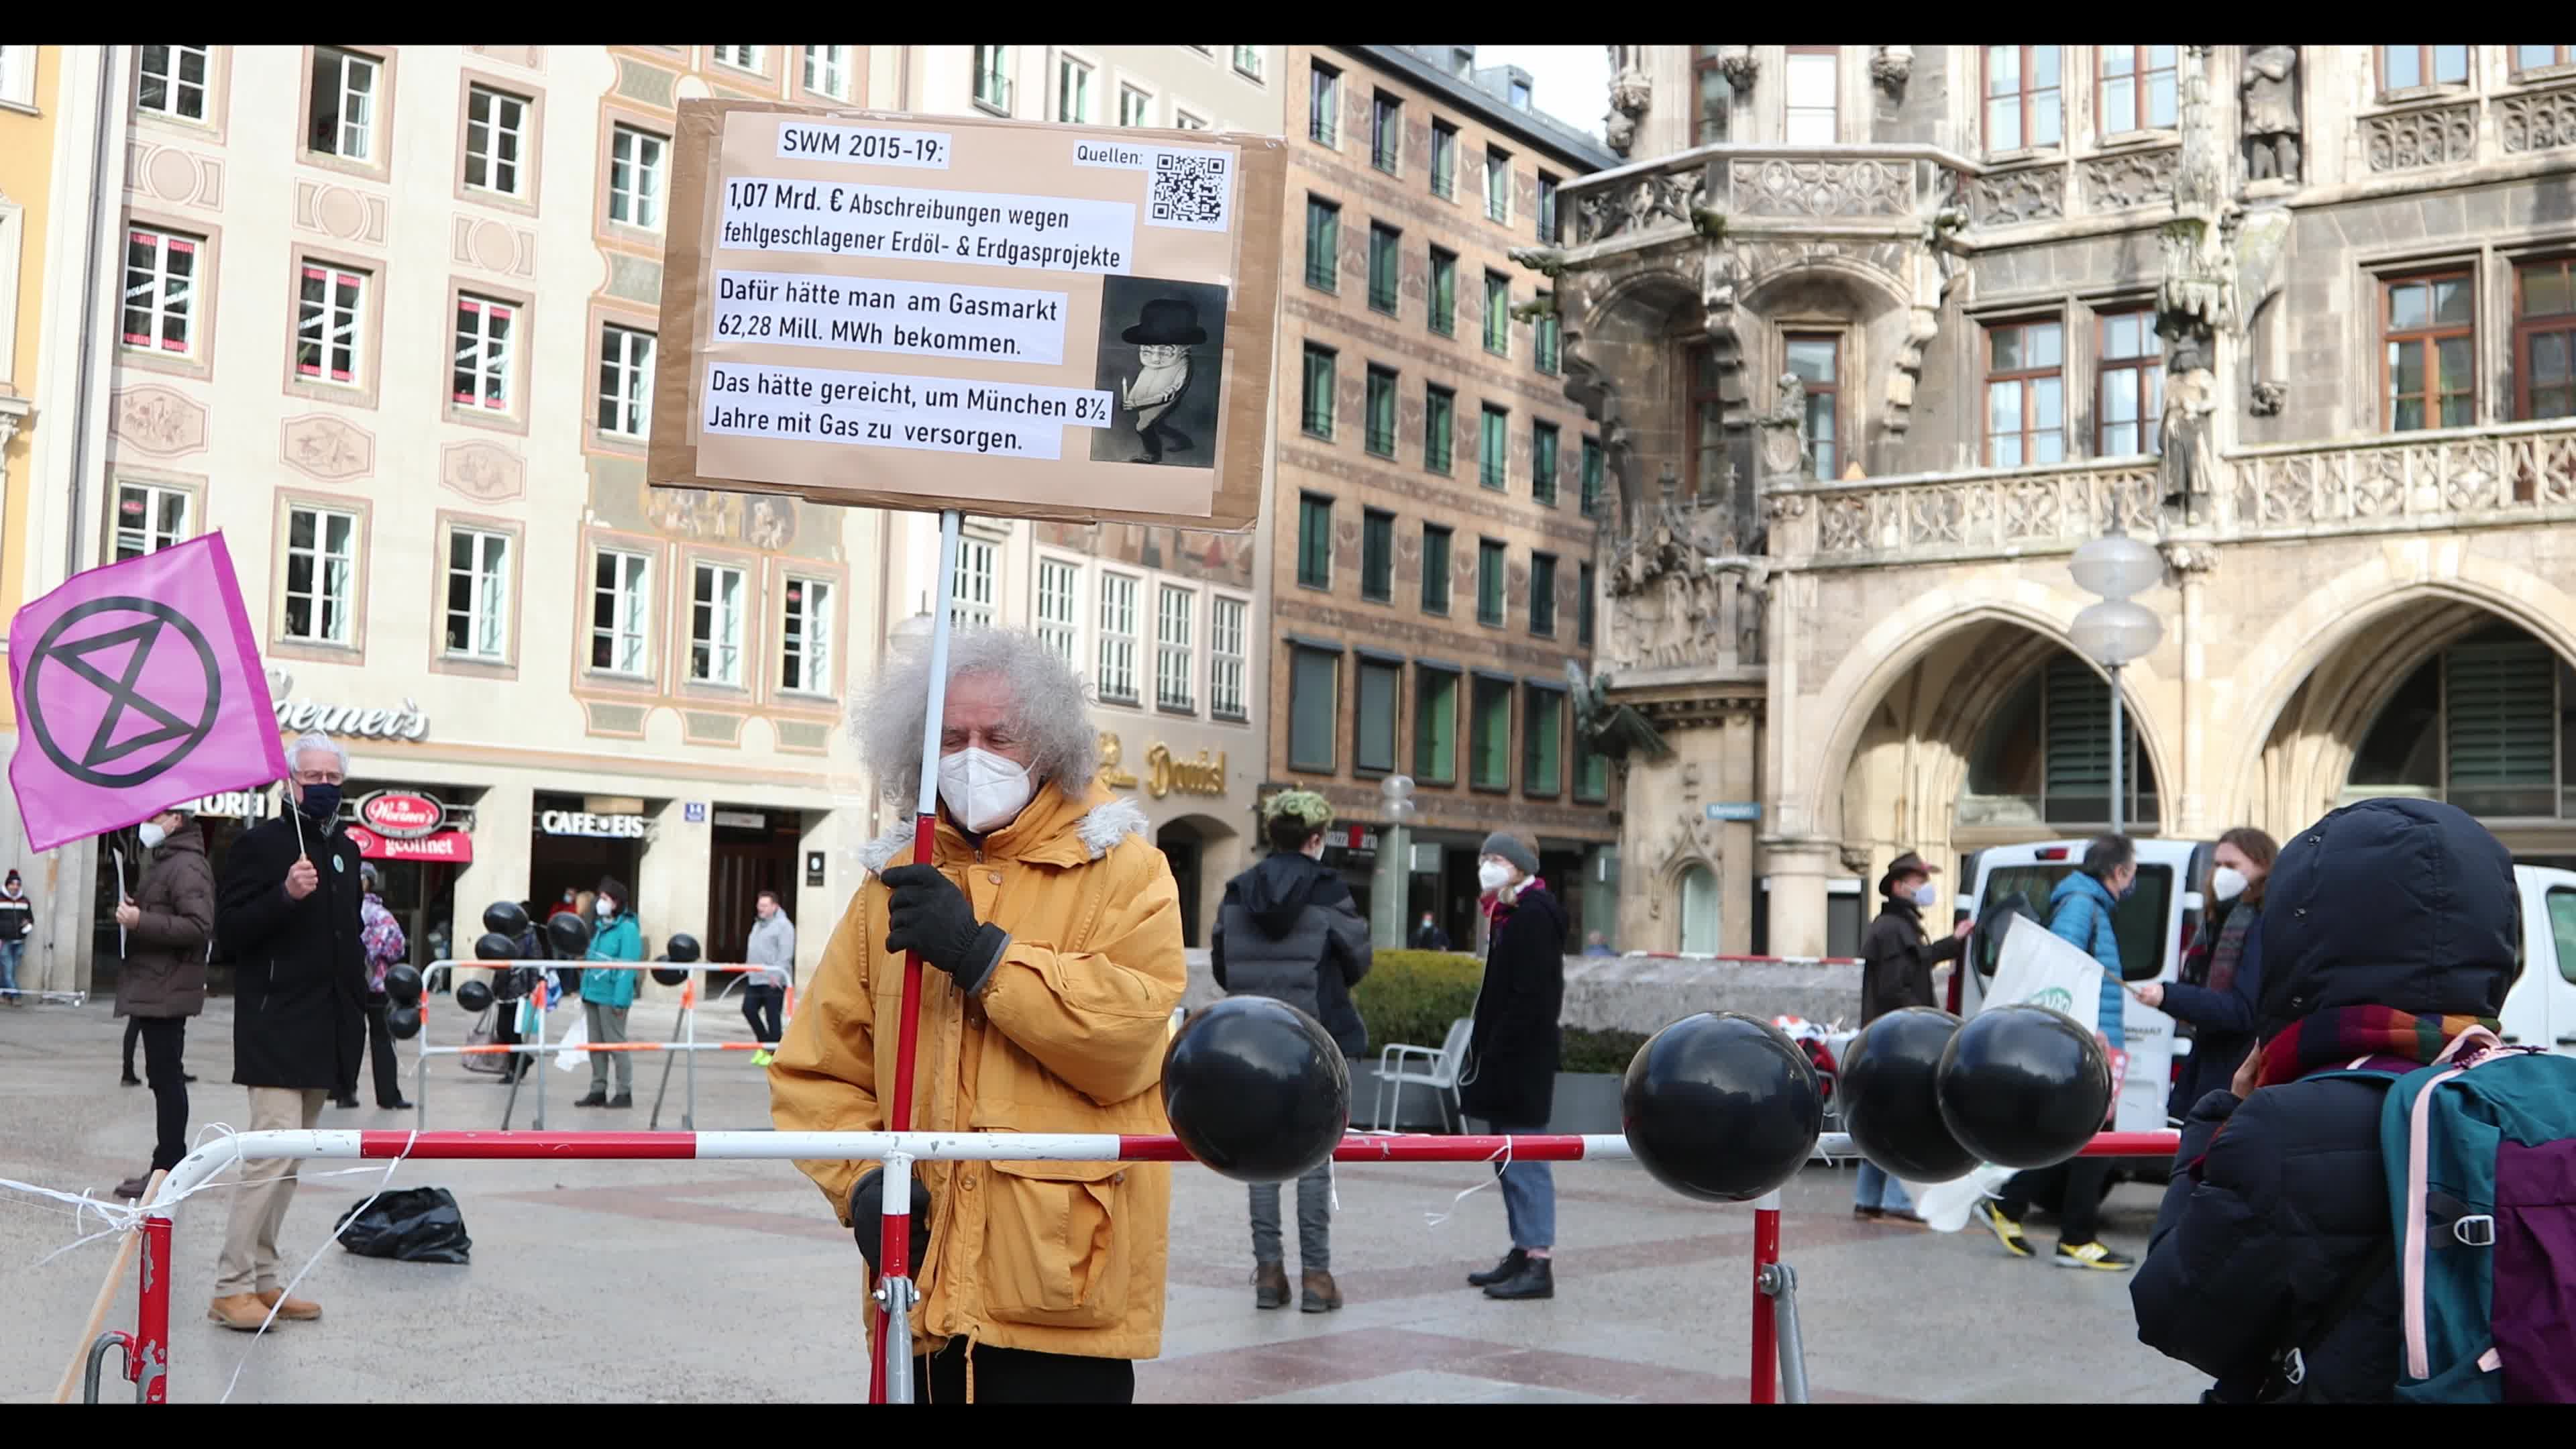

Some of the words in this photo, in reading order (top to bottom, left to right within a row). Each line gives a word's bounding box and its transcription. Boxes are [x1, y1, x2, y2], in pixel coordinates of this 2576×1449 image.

[784, 129, 841, 154] SWM
[849, 135, 943, 163] 2015-19:
[1077, 145, 1144, 164] Quellen:
[730, 182, 768, 211] 1,07
[775, 184, 821, 211] Mrd.
[830, 188, 845, 213] €
[849, 193, 1001, 225] Abschreibungen
[1008, 209, 1069, 232] wegen
[724, 221, 886, 254] fehlgeschlagener
[892, 231, 949, 254] Erdöl-
[956, 235, 970, 257] &
[977, 237, 1120, 270] Erdgasprojekte
[720, 278, 779, 301] Dafür
[786, 280, 840, 305] hätte
[848, 290, 895, 309] man
[908, 295, 941, 313] am
[949, 292, 1058, 322] Gasmarkt
[718, 313, 771, 338] 62,28
[779, 316, 823, 341] Mill.
[831, 319, 882, 345] MWh
[894, 324, 1021, 356] bekommen.
[712, 370, 750, 394] Das
[757, 372, 812, 398] hätte
[820, 380, 916, 409] gereicht,
[925, 391, 959, 409] um
[967, 388, 1067, 418] München
[1075, 396, 1106, 421] 8½
[708, 405, 769, 431] Jahre
[777, 411, 812, 434] mit
[820, 413, 859, 437] Gas
[867, 423, 892, 440] zu
[904, 425, 1023, 453] versorgen.
[268, 674, 430, 743] oerner's
[541, 810, 596, 836] CAFE
[612, 815, 644, 839] EIS
